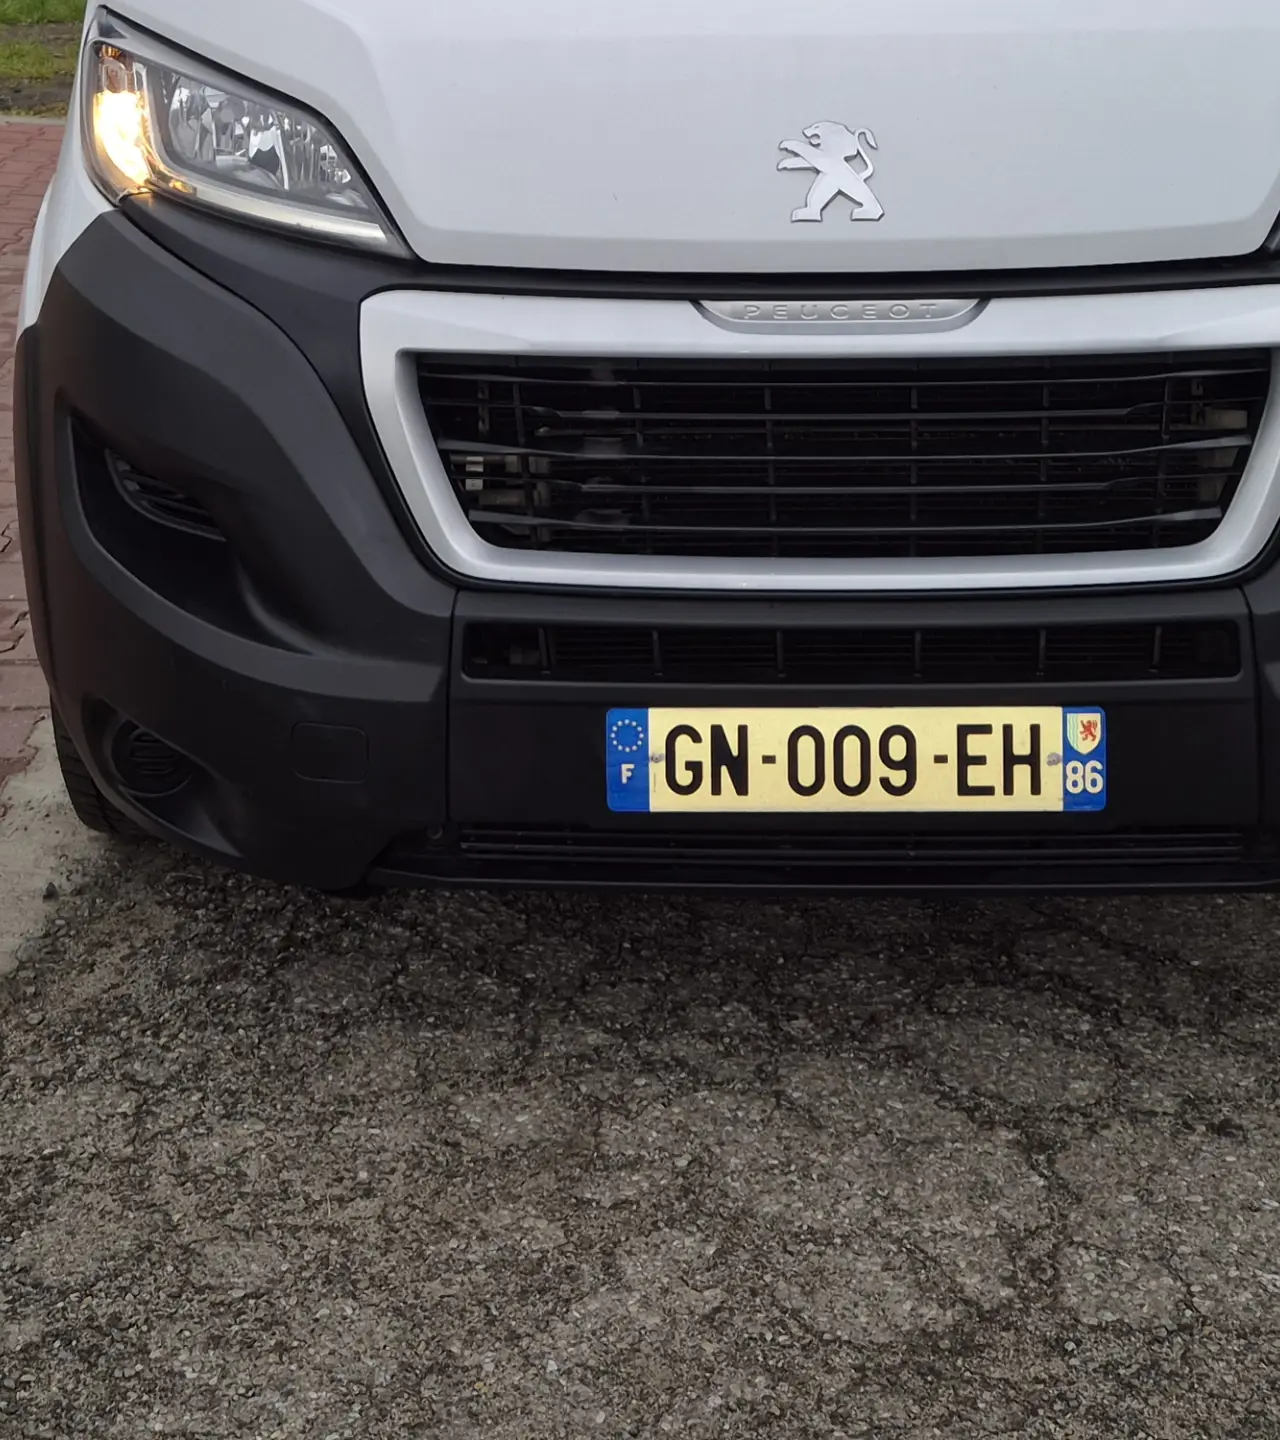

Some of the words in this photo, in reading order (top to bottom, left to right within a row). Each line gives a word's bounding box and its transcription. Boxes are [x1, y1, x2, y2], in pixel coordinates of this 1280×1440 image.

[743, 303, 938, 320] PEUGEOT
[620, 763, 634, 785] F
[664, 723, 1042, 797] GN-009-EH
[1065, 759, 1104, 795] 86
